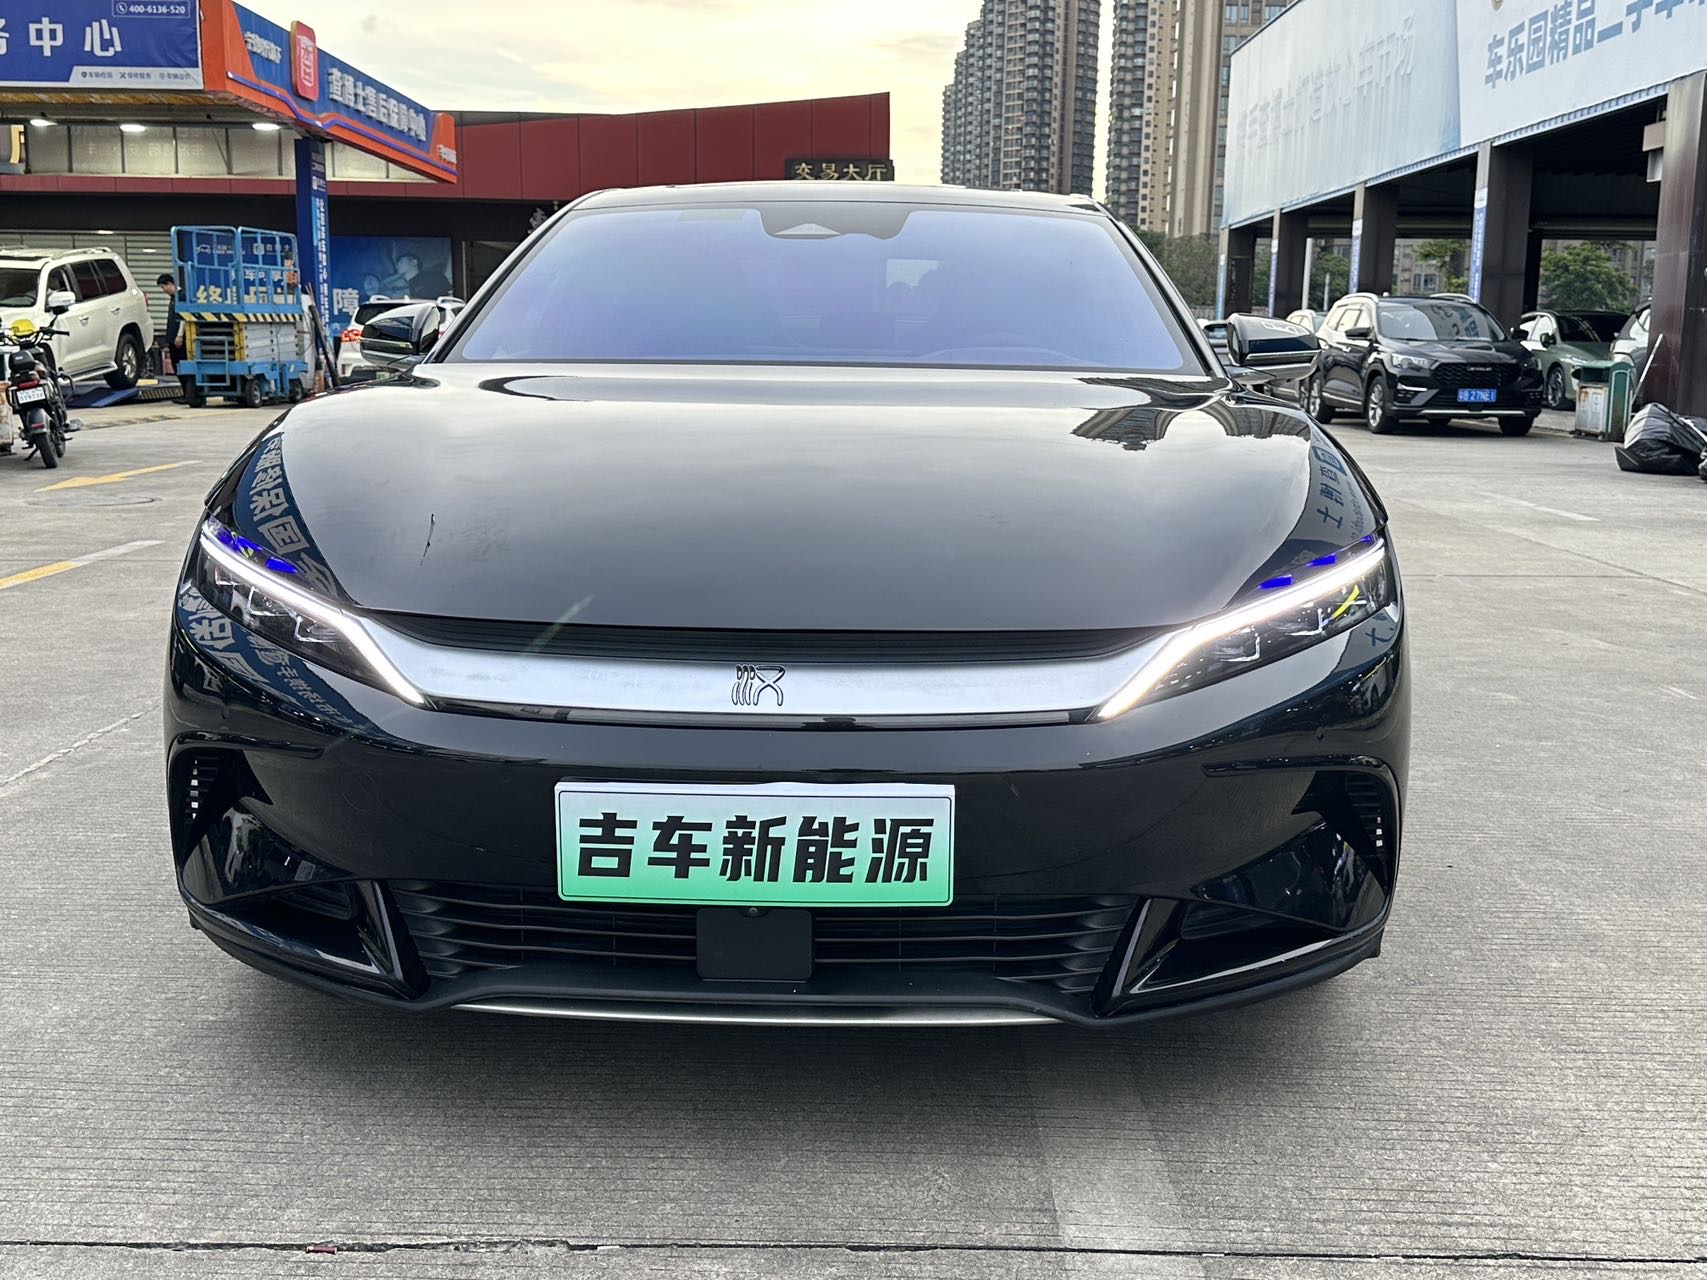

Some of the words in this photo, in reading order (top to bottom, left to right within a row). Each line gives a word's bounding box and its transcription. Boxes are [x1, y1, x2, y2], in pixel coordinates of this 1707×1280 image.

[129, 5, 186, 14] 400-6136-520
[0, 17, 122, 57] 中心
[1484, 0, 1707, 88] 车乐园精品二手
[794, 162, 888, 180] 交易大厅
[577, 812, 935, 883] 吉车新能源
